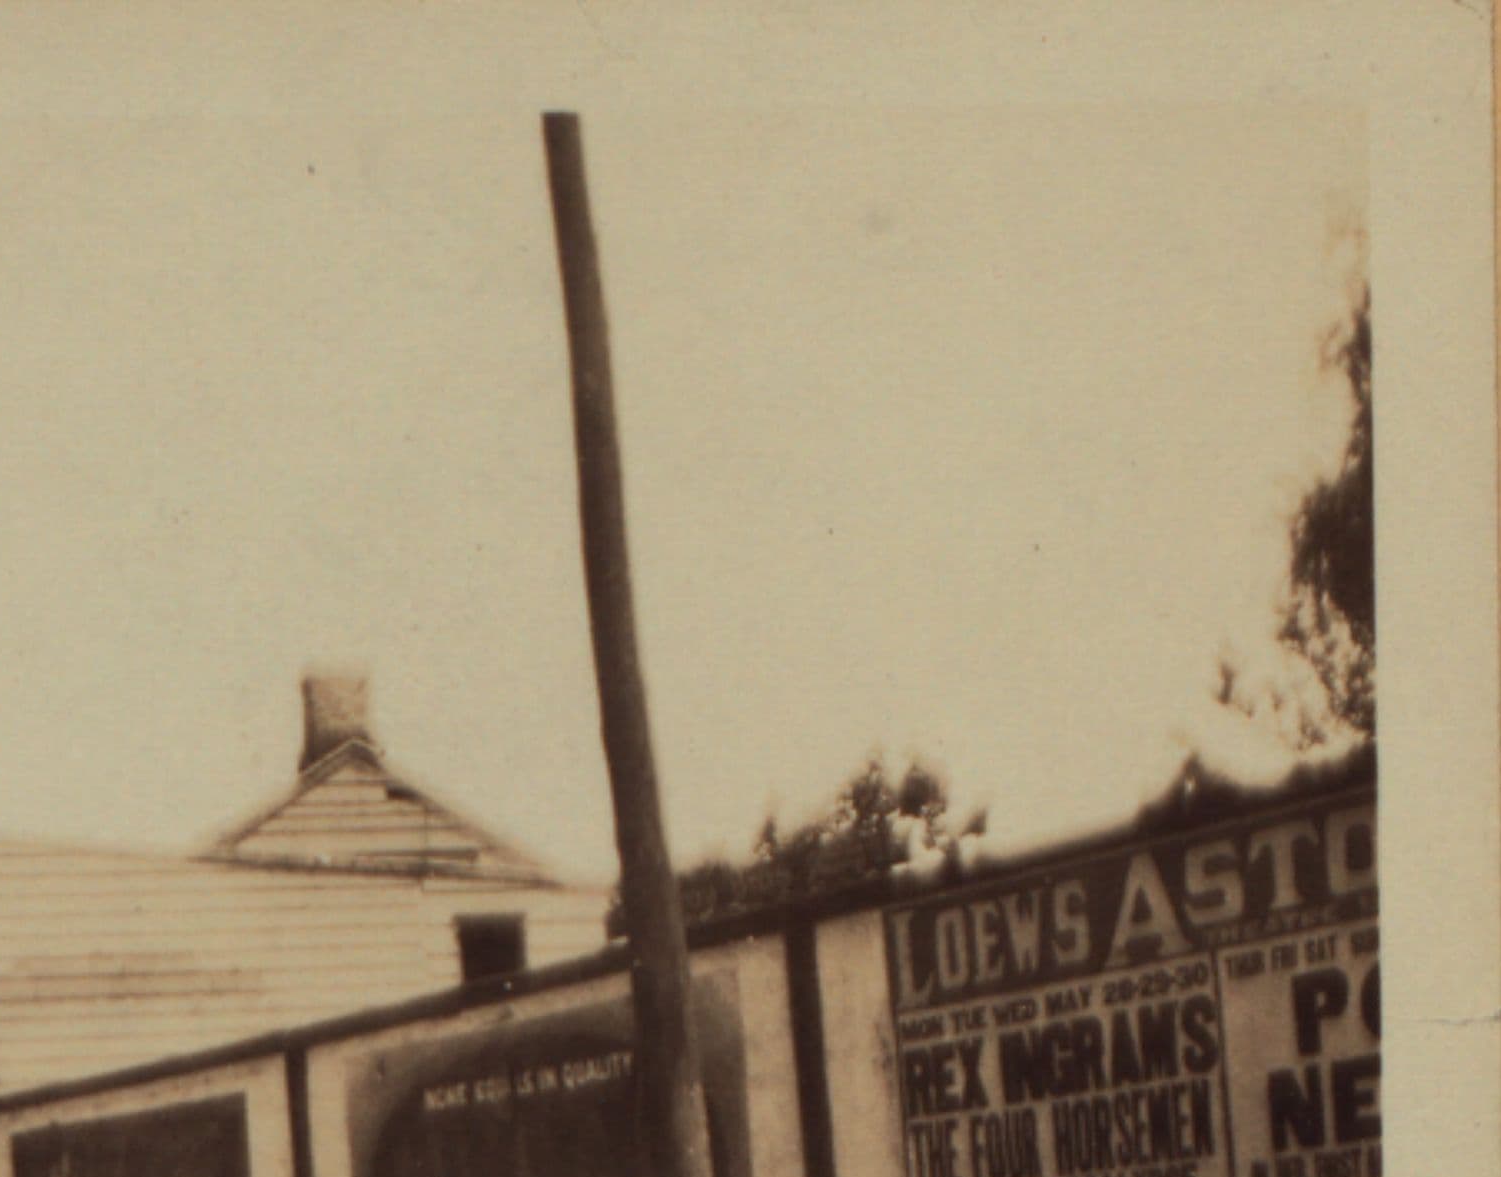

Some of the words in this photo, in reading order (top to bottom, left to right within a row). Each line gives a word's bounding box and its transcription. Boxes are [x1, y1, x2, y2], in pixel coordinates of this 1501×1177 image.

[894, 879, 1092, 1008] LOEWS
[1305, 932, 1338, 963] SAT
[1045, 984, 1091, 1016] MAY
[563, 1052, 633, 1089] QUALITY
[903, 1036, 989, 1116] REX
[999, 993, 1219, 1104] INGRAMS
[1051, 1079, 1215, 1175] HORSEMEN
